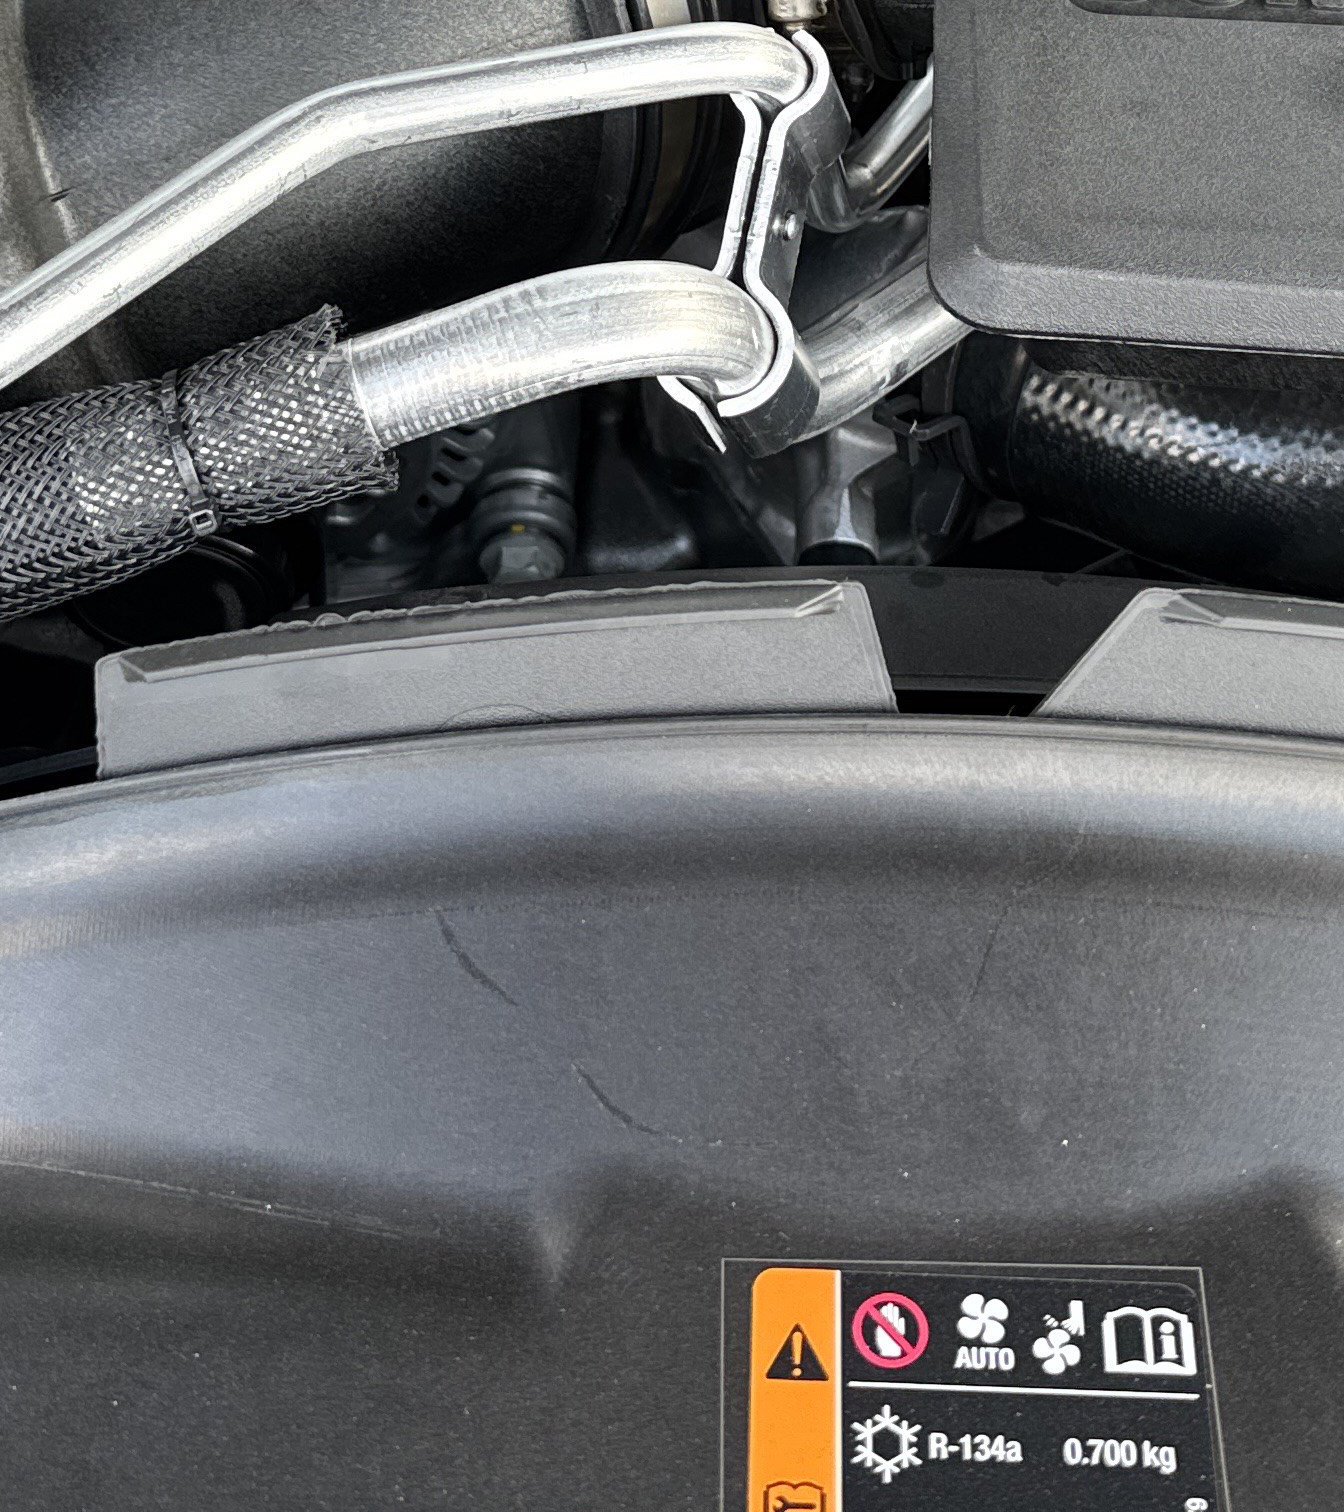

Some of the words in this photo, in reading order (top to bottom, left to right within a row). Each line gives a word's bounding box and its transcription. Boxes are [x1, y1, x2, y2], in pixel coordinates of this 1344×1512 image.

[954, 1346, 1016, 1372] AUTO
[927, 1432, 1023, 1463] R-134a
[1063, 1437, 1138, 1467] 0.700
[1141, 1439, 1177, 1475] kg
